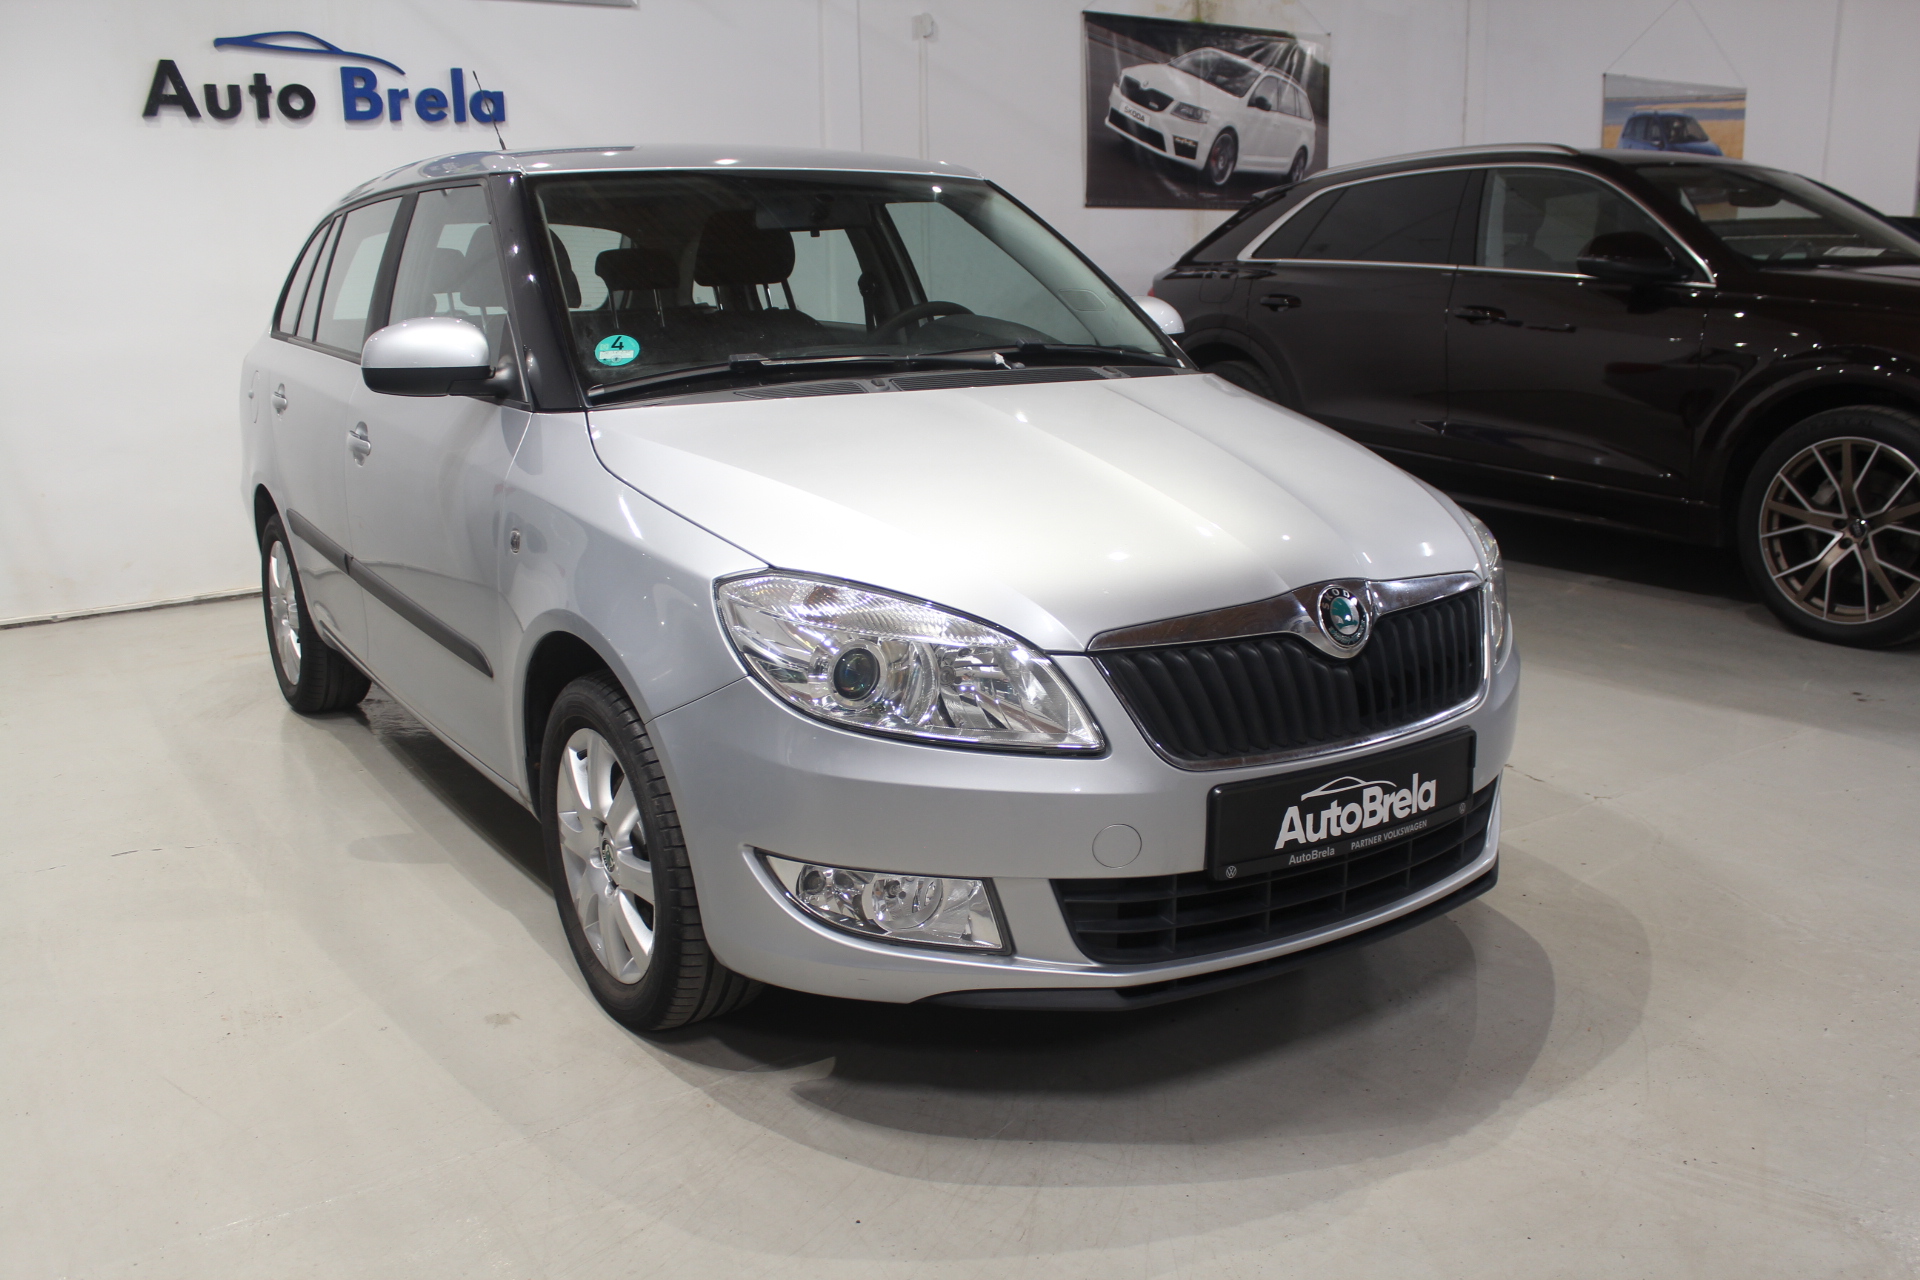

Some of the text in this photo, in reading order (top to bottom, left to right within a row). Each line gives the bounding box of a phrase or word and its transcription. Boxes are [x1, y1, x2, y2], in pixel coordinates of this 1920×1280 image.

[142, 59, 506, 124] Auto Brela
[610, 335, 625, 350] 4
[1274, 772, 1437, 850] AutoBrela
[1350, 819, 1428, 851] PARTNER VOLKSWAGEN
[1288, 846, 1335, 866] AutoBrela
